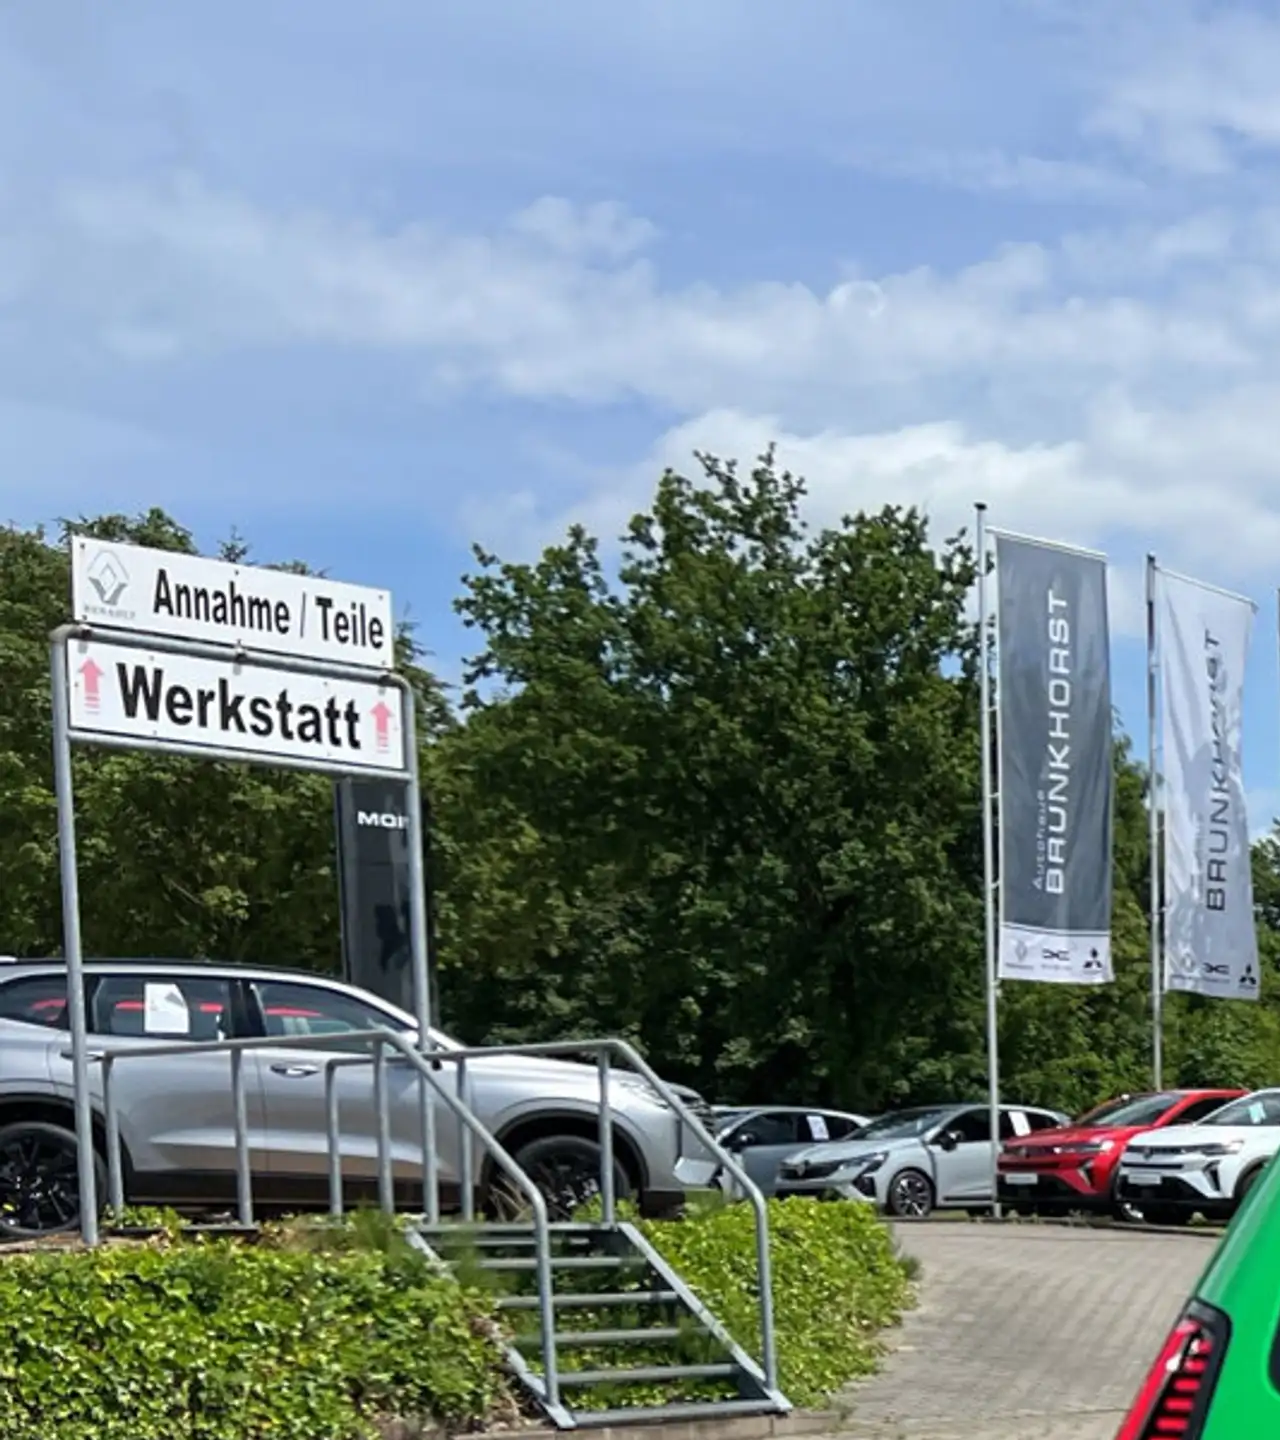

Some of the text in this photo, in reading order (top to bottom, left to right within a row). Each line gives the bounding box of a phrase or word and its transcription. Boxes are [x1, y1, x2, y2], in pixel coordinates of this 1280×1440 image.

[153, 568, 290, 634] Annahme
[315, 596, 384, 650] Teile
[116, 662, 361, 751] Werkstatt
[1046, 589, 1071, 895] BRUNKHORST
